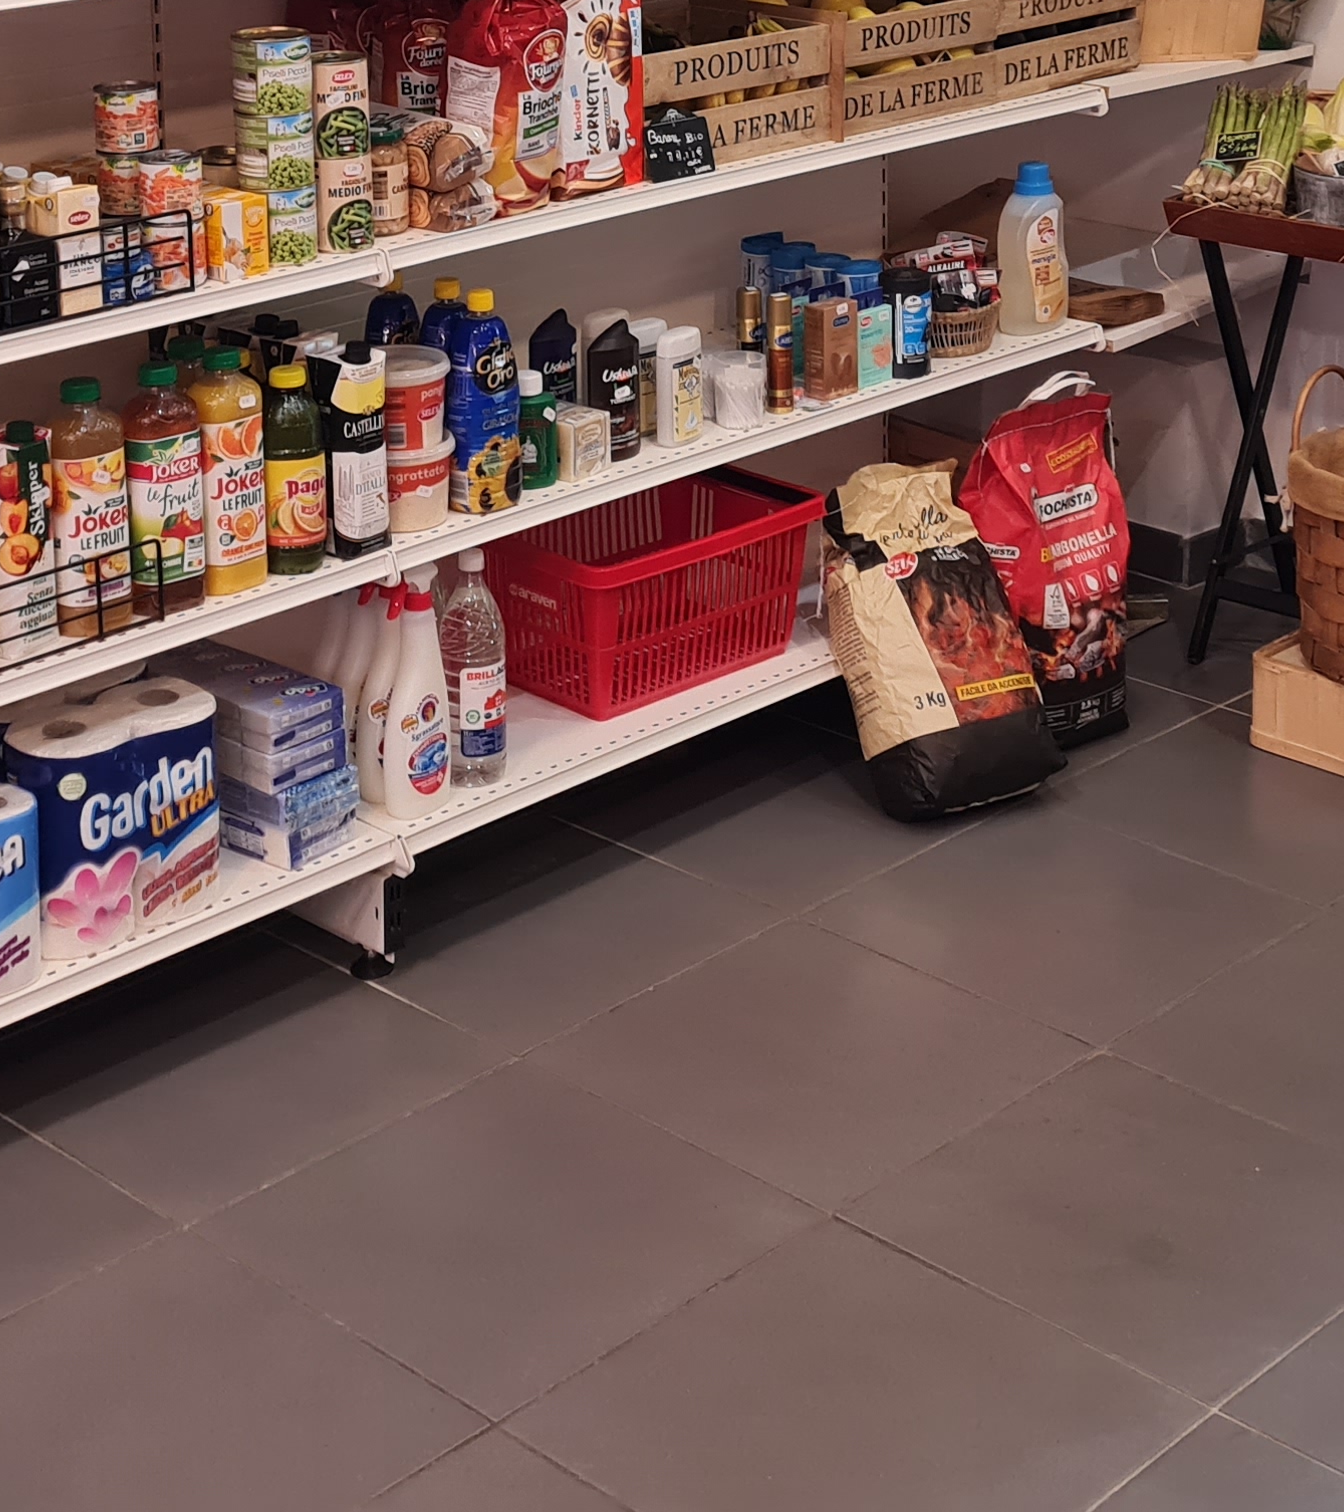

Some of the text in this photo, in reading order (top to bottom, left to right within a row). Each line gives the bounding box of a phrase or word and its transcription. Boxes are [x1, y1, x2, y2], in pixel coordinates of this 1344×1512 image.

[861, 10, 972, 51] PRODUITS
[674, 39, 801, 86] PRODUITS
[1004, 35, 1130, 86] DE LA FERME
[844, 71, 985, 122] DE LA FERME
[732, 104, 817, 144] FERME
[328, 183, 362, 198] MEDIO
[926, 259, 966, 273] ALKALINE
[149, 456, 199, 482] JOKER
[157, 478, 199, 518] fruit
[222, 487, 263, 511] LE FRUIT
[80, 526, 126, 551] LE FRUIT
[1074, 543, 1111, 564] QUALITY
[914, 692, 946, 710] 3 Kg
[960, 682, 999, 697] FACILE DA
[79, 747, 213, 852] Garden
[150, 779, 216, 838] ULTRA
